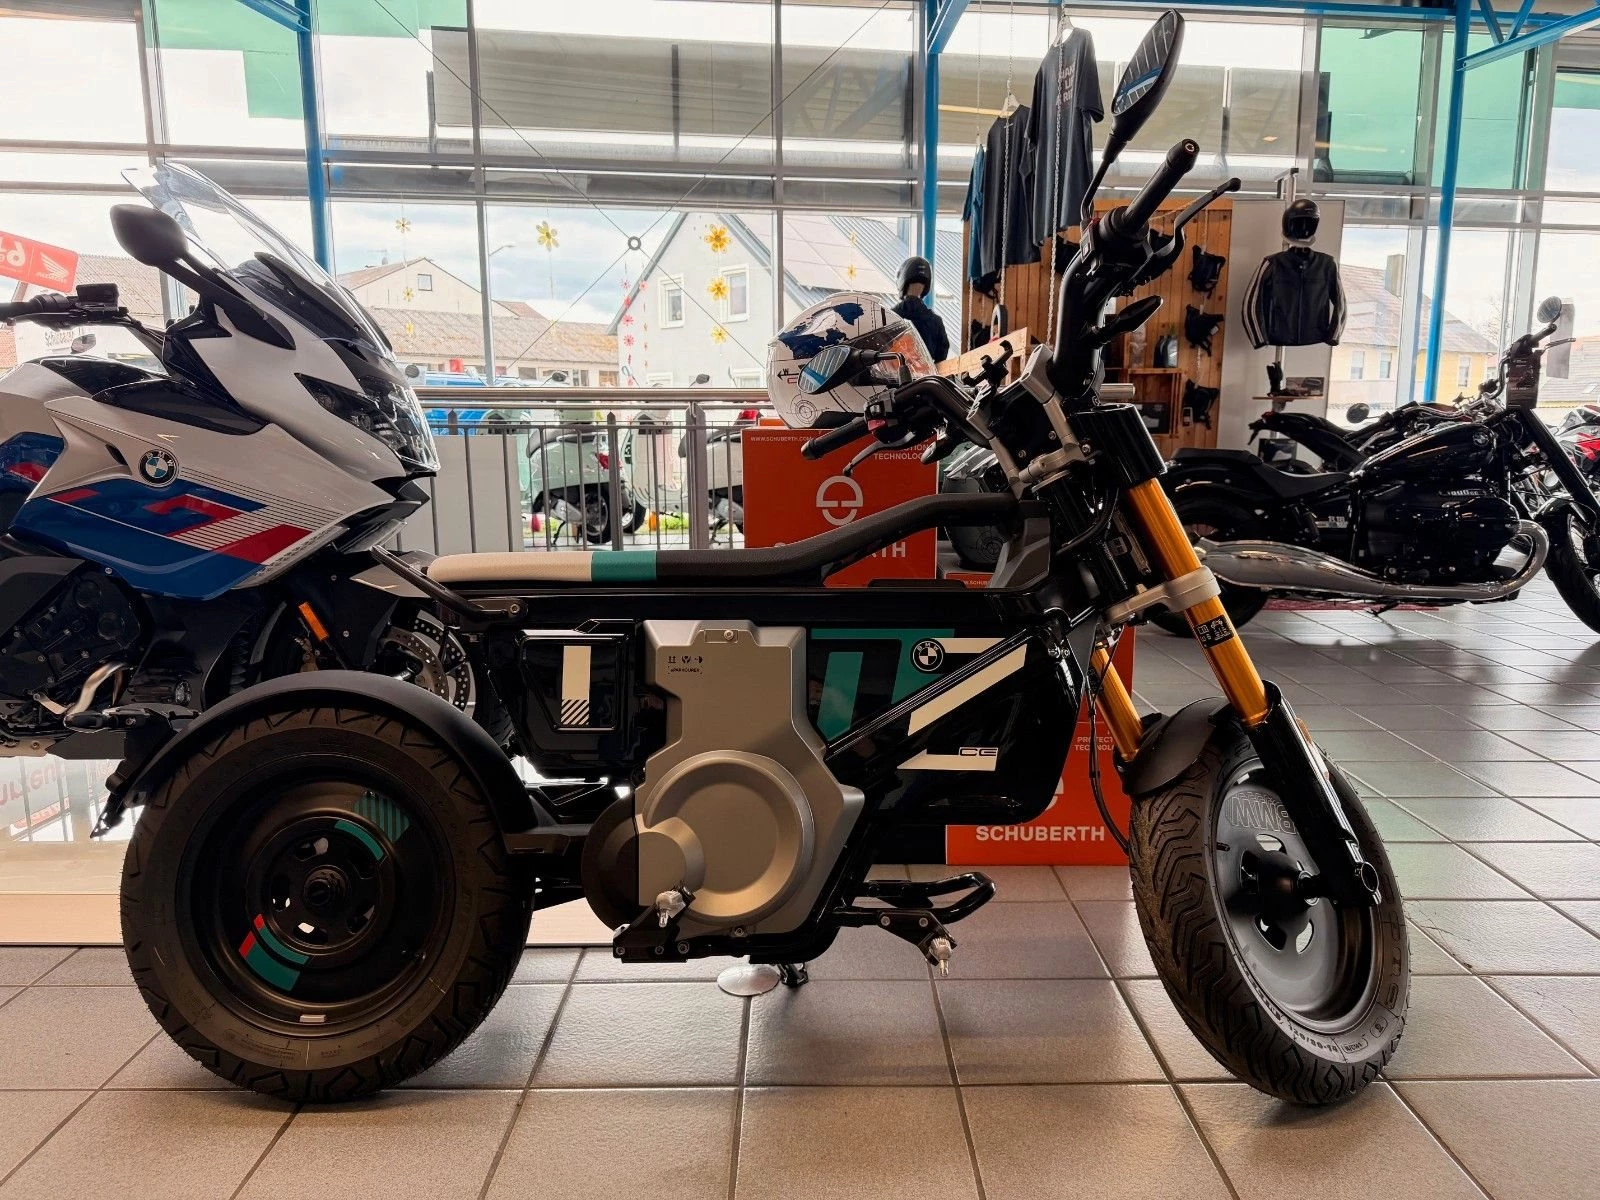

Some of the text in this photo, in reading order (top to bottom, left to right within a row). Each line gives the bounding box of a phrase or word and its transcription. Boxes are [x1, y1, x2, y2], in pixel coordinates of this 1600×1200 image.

[146, 450, 175, 467] BMW
[917, 642, 940, 652] BMW
[975, 825, 1105, 841] SCHUBERTH
